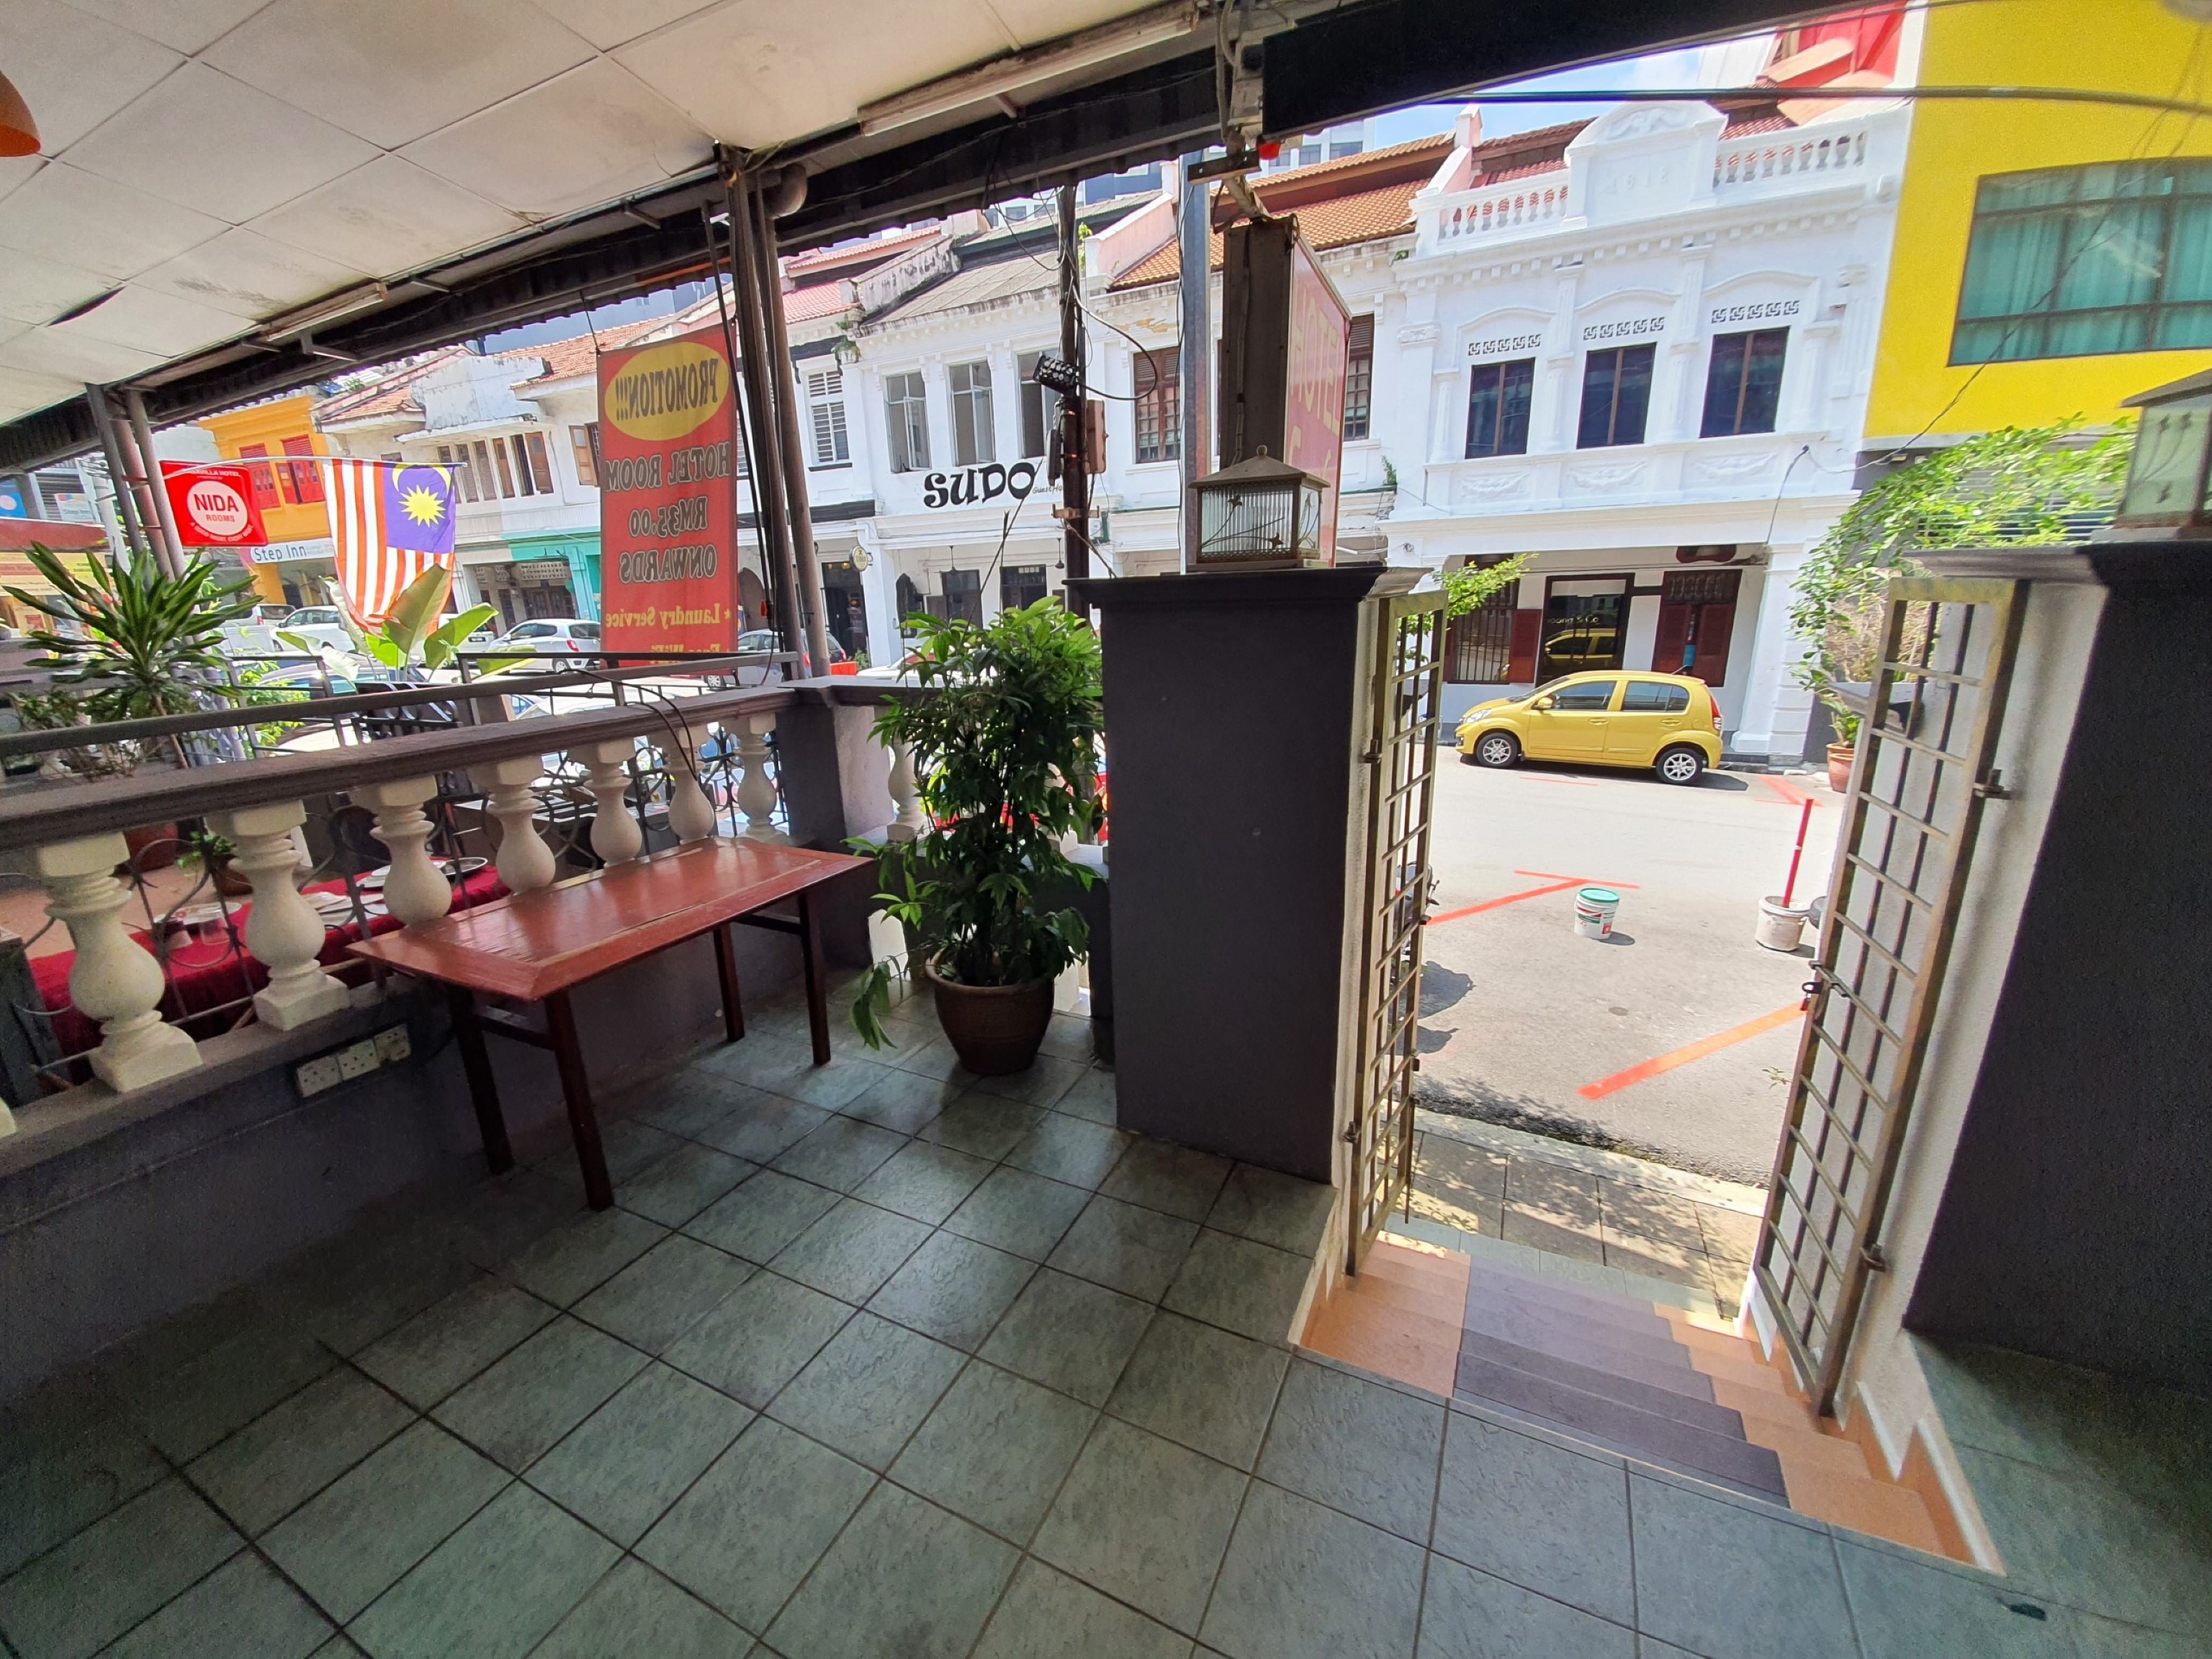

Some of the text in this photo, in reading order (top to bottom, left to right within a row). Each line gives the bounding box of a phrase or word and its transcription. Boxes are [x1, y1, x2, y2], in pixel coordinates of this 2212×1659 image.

[1290, 274, 1340, 437] HOTEL
[924, 462, 1035, 508] SUDO
[194, 494, 239, 513] NIDA
[206, 514, 235, 523] ROOMS
[254, 547, 283, 561] Step
[285, 545, 307, 559] Inn
